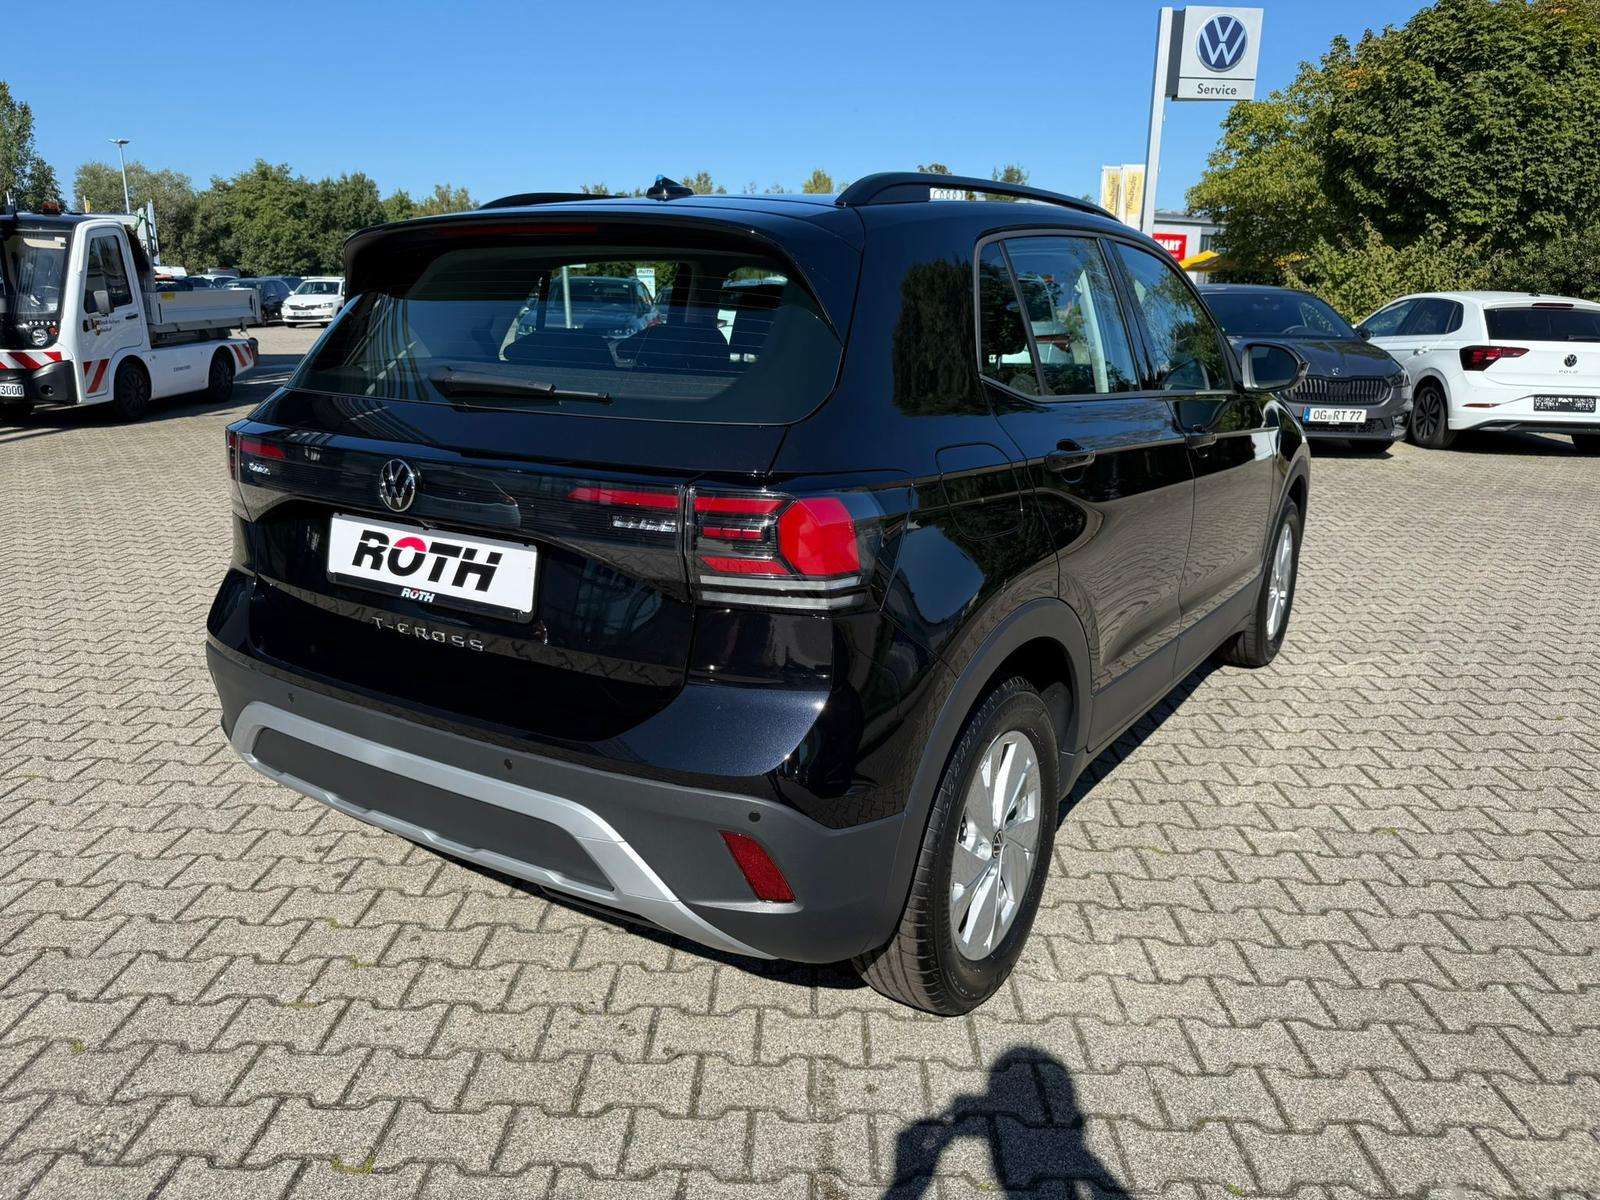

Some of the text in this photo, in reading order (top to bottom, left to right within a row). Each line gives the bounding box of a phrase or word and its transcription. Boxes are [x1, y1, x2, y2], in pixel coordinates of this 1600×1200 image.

[1197, 83, 1237, 95] Service
[1313, 410, 1363, 421] OG RT 77
[352, 529, 503, 593] ROTH
[401, 587, 435, 603] ROTH
[371, 616, 485, 652] T-CROSS
